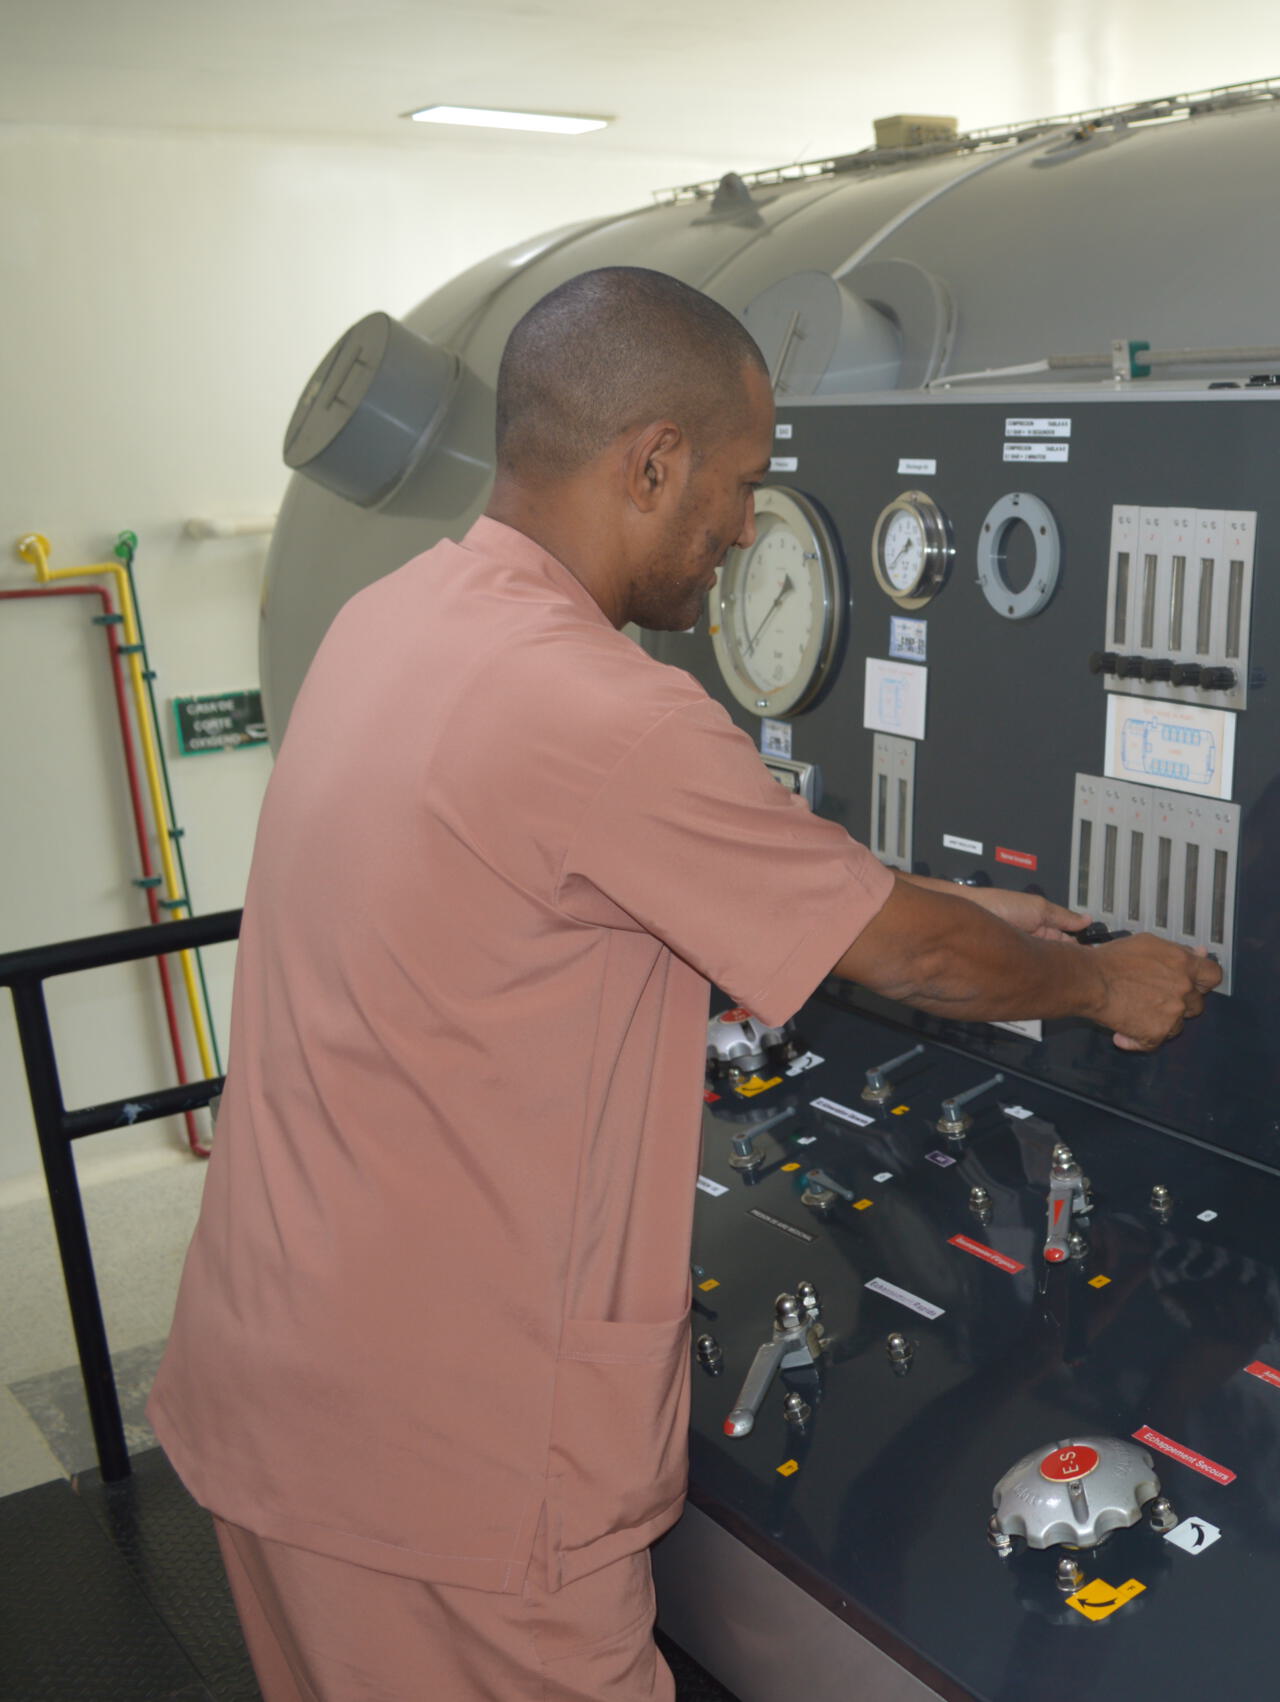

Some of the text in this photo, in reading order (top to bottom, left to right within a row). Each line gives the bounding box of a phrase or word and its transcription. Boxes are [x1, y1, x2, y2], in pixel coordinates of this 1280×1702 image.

[1059, 1451, 1079, 1475] E-S
[1143, 1432, 1230, 1481] Echappement Secours
